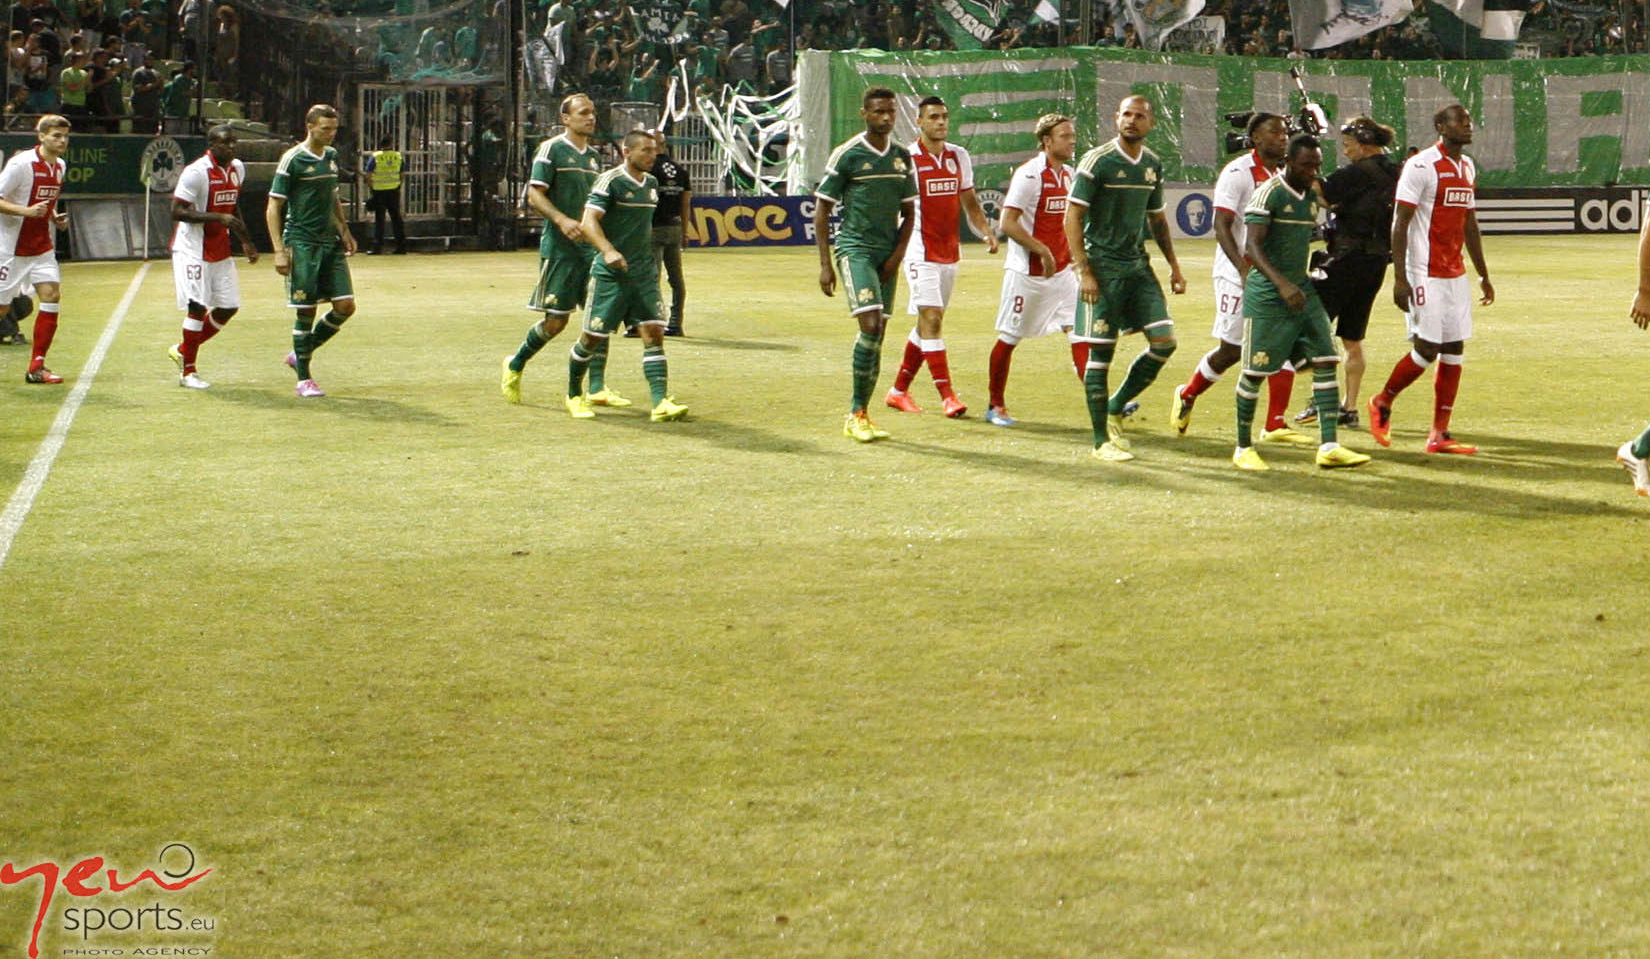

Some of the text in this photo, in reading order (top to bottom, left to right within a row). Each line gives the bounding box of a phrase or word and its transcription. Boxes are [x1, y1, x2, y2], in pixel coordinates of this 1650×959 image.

[930, 181, 956, 192] BASE
[1049, 199, 1066, 211] BAS
[187, 264, 202, 280] 63
[909, 262, 919, 280] 5
[1013, 295, 1024, 314] 8
[1220, 293, 1242, 316] 67
